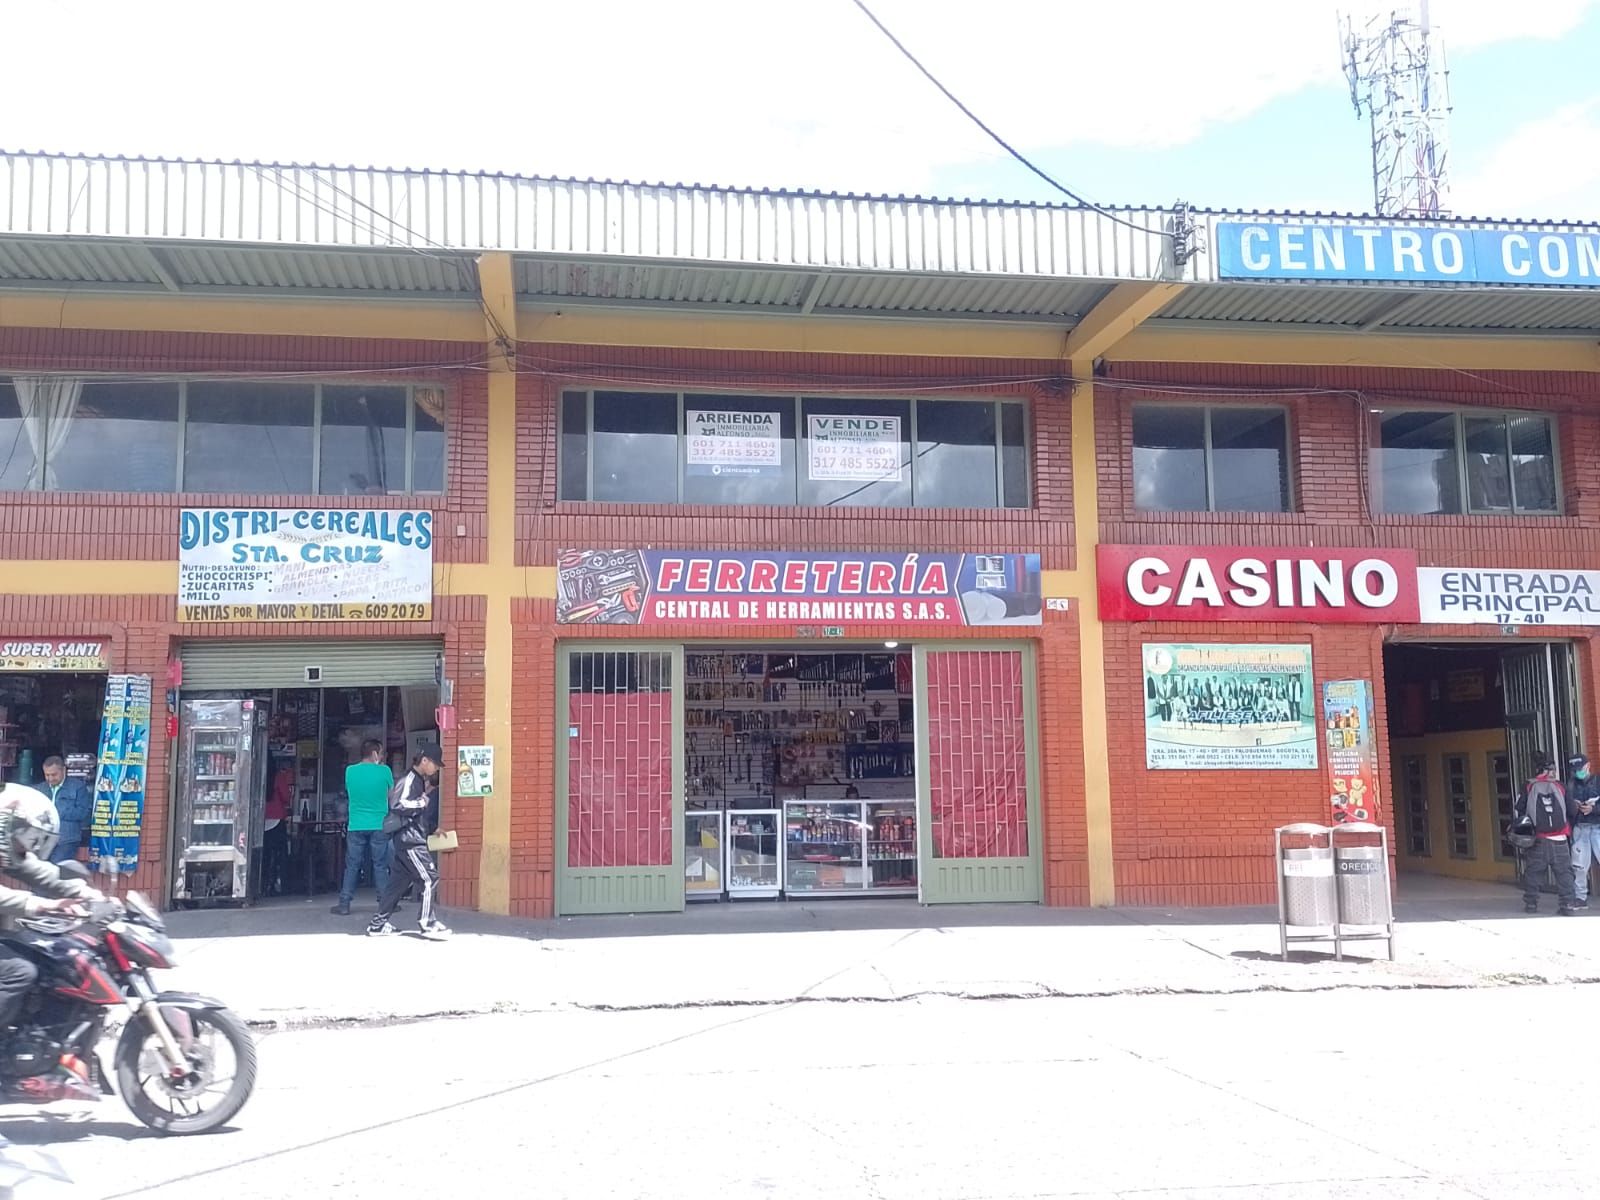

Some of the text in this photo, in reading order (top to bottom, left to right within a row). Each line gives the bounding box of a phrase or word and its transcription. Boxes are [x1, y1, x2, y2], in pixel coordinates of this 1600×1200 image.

[1240, 226, 1464, 275] CENTRO
[695, 413, 773, 424] ARRIENDA
[816, 418, 894, 430] VENDE
[717, 424, 770, 432] INMOBILIARIA
[692, 448, 714, 457] 317
[745, 448, 776, 458] 5522
[813, 457, 897, 470] 317 485 5522
[180, 510, 432, 550] DISTRI-CEREALES
[232, 542, 383, 564] STA. CRUZ
[655, 553, 950, 594] FERRETERÍA
[187, 582, 254, 591] ZUCARITAS
[1125, 557, 1399, 609] CASINO
[1441, 572, 1592, 594] ENTRADA
[186, 592, 220, 600] MILO
[1440, 594, 1600, 612] PRINCIPAL
[185, 604, 425, 620] VENTAS POR MAYOR Y DETAL 609 20 79
[655, 600, 950, 621] CENTRAL DE HERRAMIENTAS S.A.S.
[1495, 614, 1510, 623] 17
[1524, 614, 1544, 623] 40
[1, 642, 102, 657] SUPER SANTI
